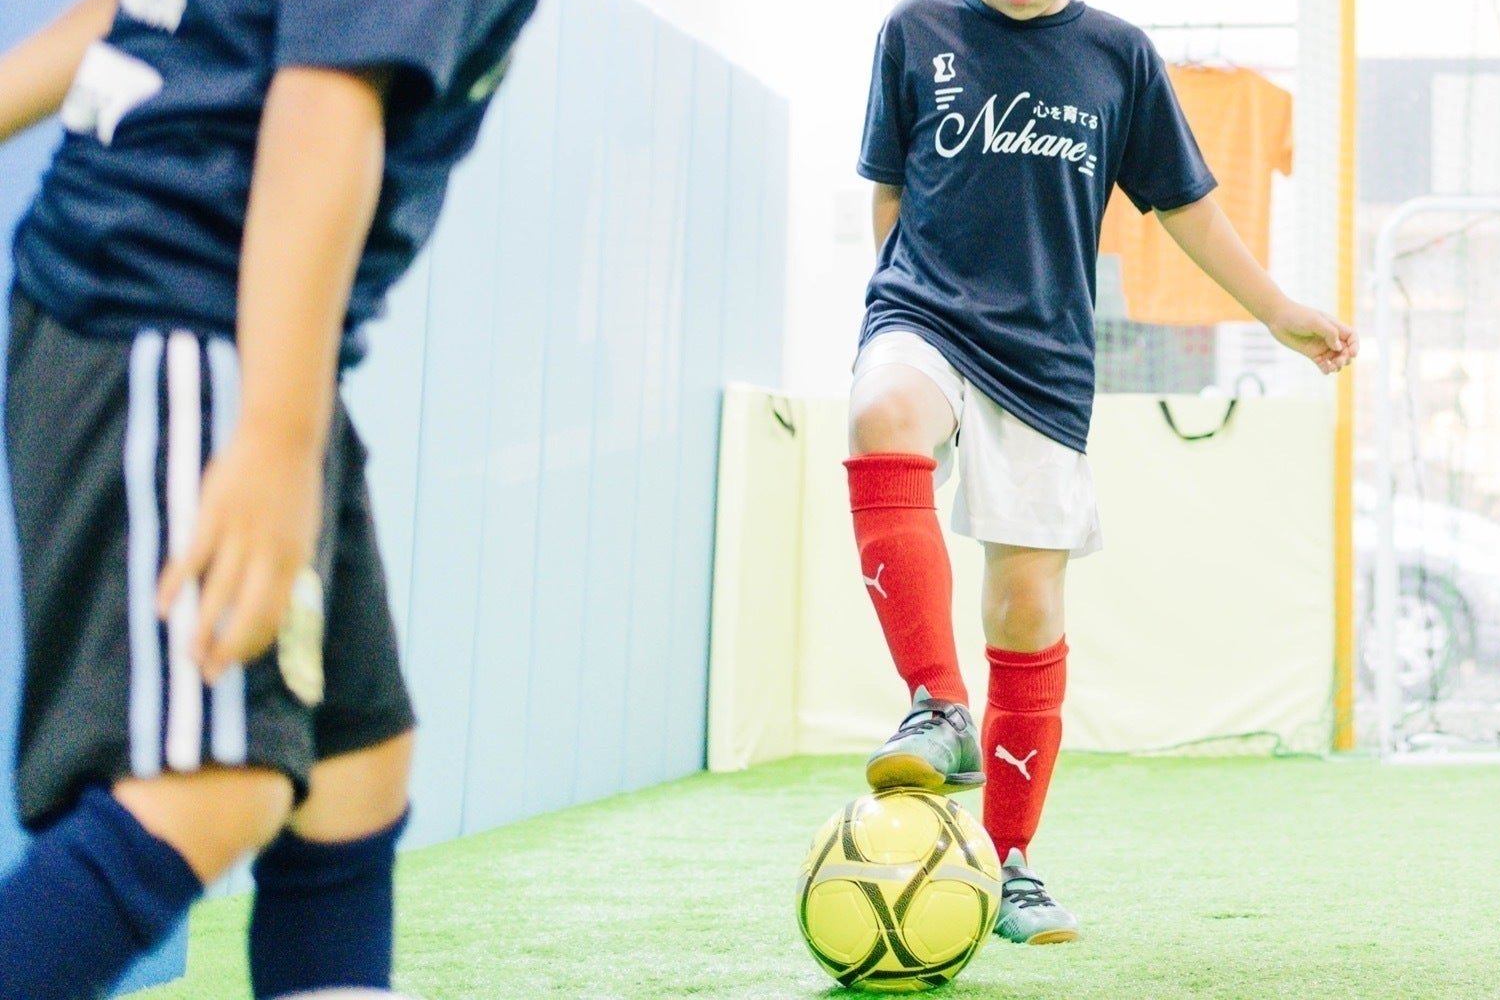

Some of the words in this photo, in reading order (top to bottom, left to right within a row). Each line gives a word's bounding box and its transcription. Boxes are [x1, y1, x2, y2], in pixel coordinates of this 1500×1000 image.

[935, 91, 1088, 162] Nakane
[1033, 100, 1099, 130] 心を育てる
